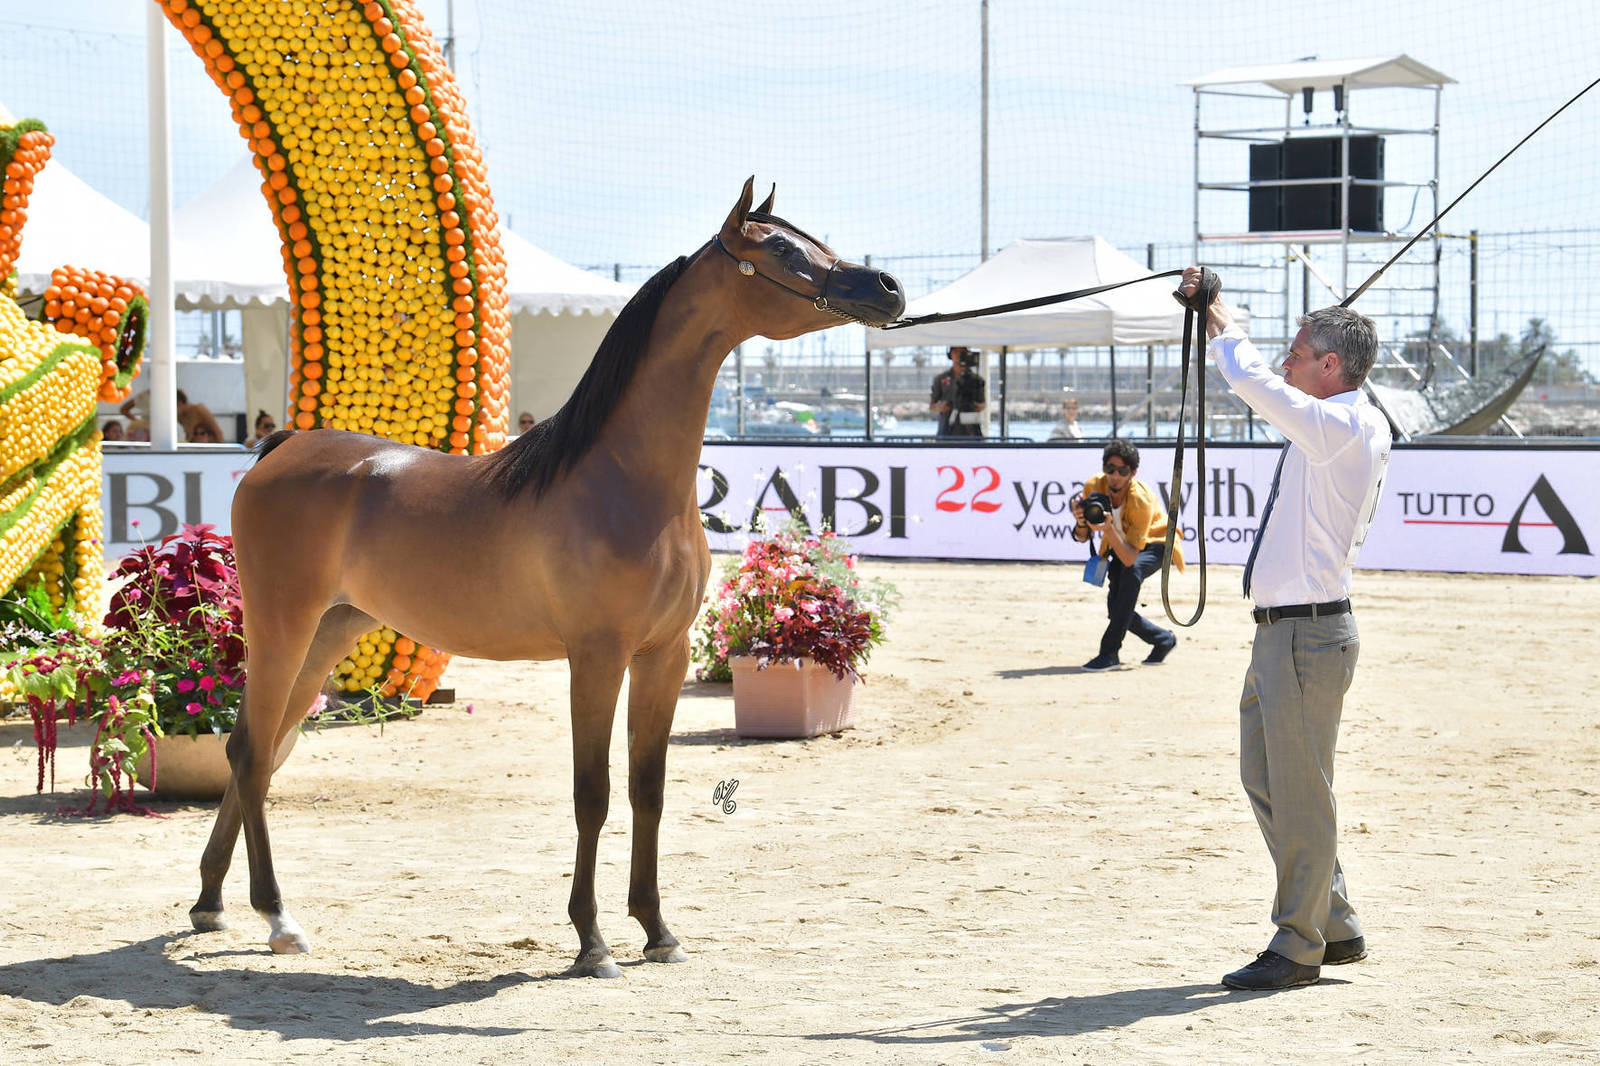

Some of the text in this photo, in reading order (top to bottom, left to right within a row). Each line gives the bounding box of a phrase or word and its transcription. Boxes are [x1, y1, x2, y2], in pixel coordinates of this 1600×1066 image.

[935, 465, 1003, 514] 22
[1157, 467, 1256, 518] wth
[1398, 492, 1495, 517] TUTTO
[1500, 472, 1595, 557] A
